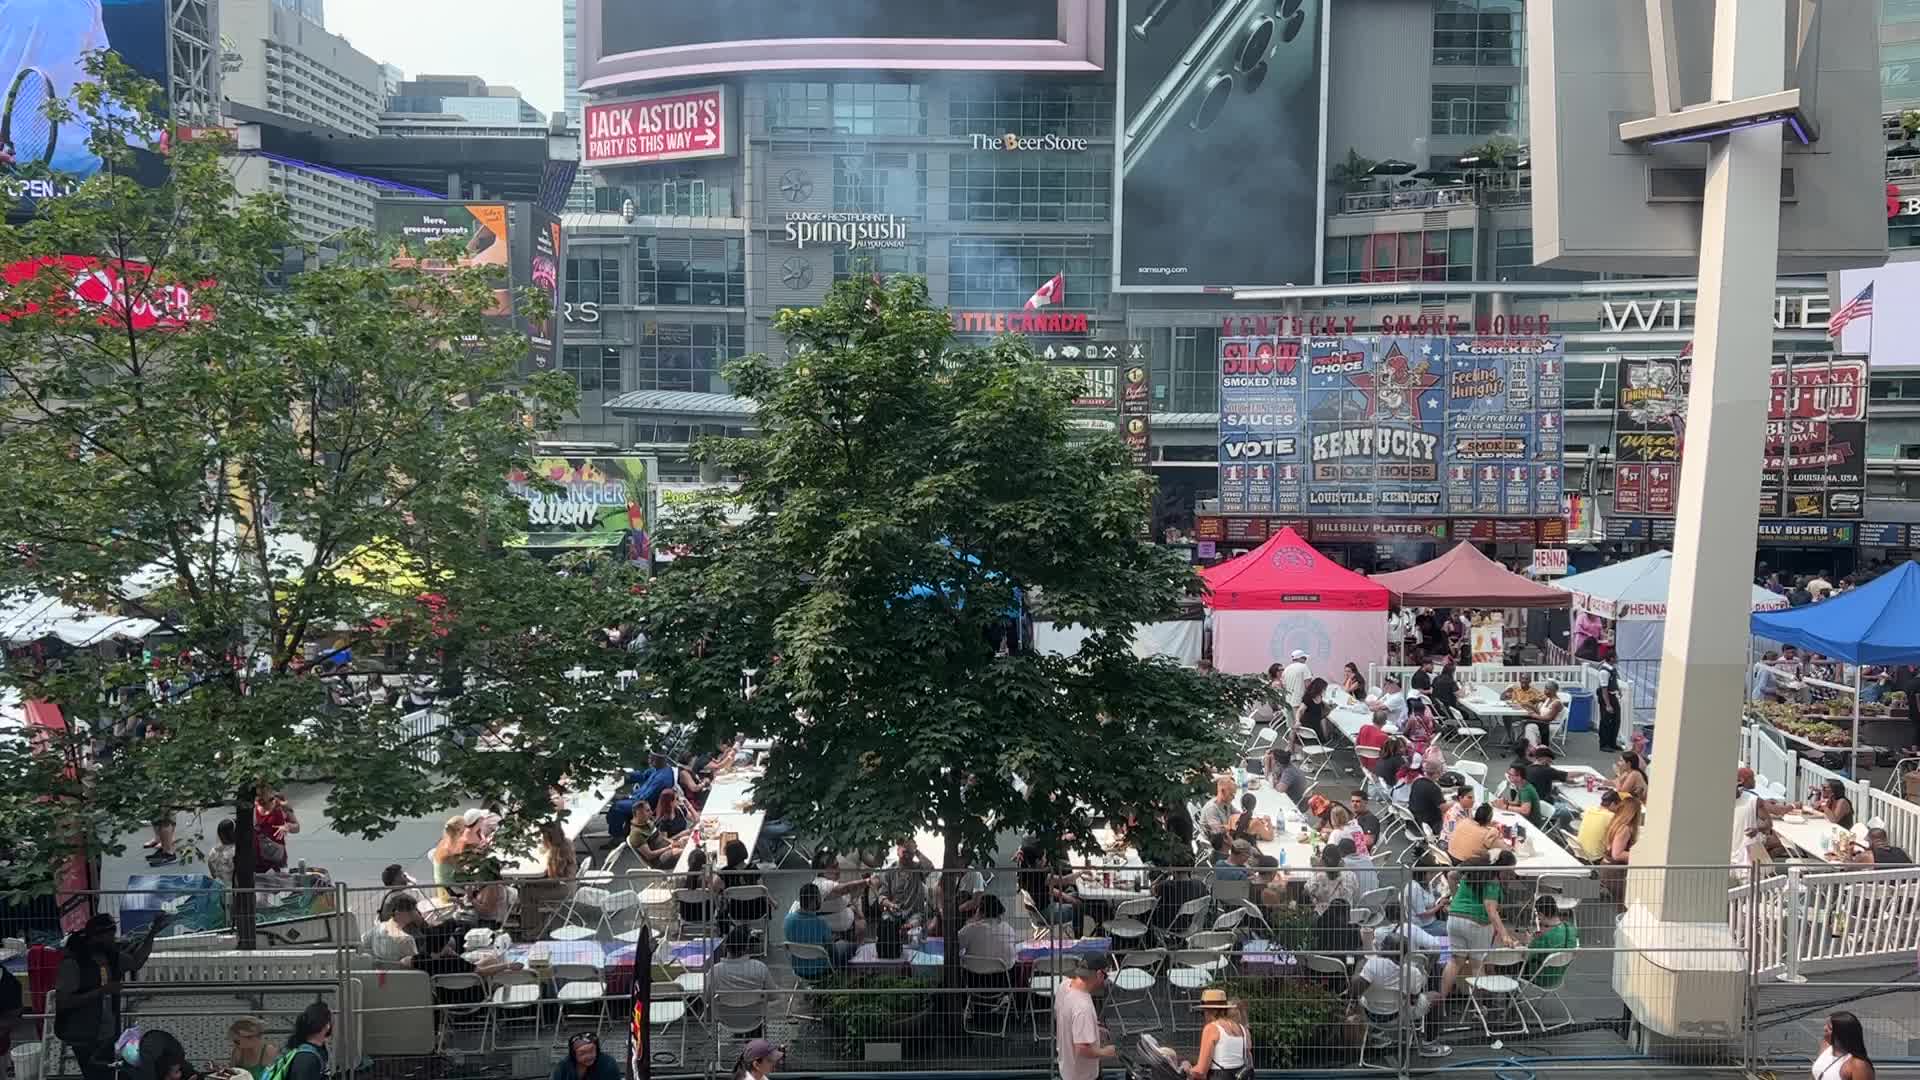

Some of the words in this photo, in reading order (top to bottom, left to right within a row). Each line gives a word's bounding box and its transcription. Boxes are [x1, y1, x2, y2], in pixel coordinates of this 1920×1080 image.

[590, 108, 634, 139] JACK
[638, 99, 717, 135] ASTOR'S
[590, 138, 625, 157] PARTY
[626, 137, 638, 154] IS
[639, 134, 665, 153] THIS
[666, 131, 693, 150] WAY
[969, 133, 1003, 151] The
[1003, 133, 1044, 151] Beer
[1044, 133, 1089, 151] Store
[423, 216, 448, 226] Here,
[785, 211, 823, 222] LOUNGE
[827, 212, 888, 223] RESTAURANT
[403, 226, 440, 236] greenery
[785, 221, 857, 250] spring
[857, 213, 907, 240] sushi
[1138, 267, 1188, 276] samsung.com
[1008, 312, 1089, 333] CANADA
[1222, 315, 1357, 337] KENTUCKY
[1381, 314, 1459, 337] SMOKE
[1311, 341, 1339, 349] VOTE
[1223, 343, 1301, 376] SLOW
[1223, 376, 1270, 388] SMOKED
[1452, 368, 1497, 386] Feeling
[1451, 379, 1505, 400] Hungry?
[1227, 414, 1294, 426] SAUCES
[1225, 438, 1295, 459] VOTE
[1312, 428, 1438, 463] KENTUCKY
[1378, 466, 1433, 480] HOUSE
[527, 502, 599, 525] SLUSHY
[1316, 522, 1370, 534] HILLBILLY
[1372, 523, 1423, 534] PLATTER
[1759, 525, 1783, 535] ELLY
[1784, 525, 1829, 536] BUSTER
[1536, 551, 1566, 567] HENNA
[1630, 604, 1667, 616] HENNA
